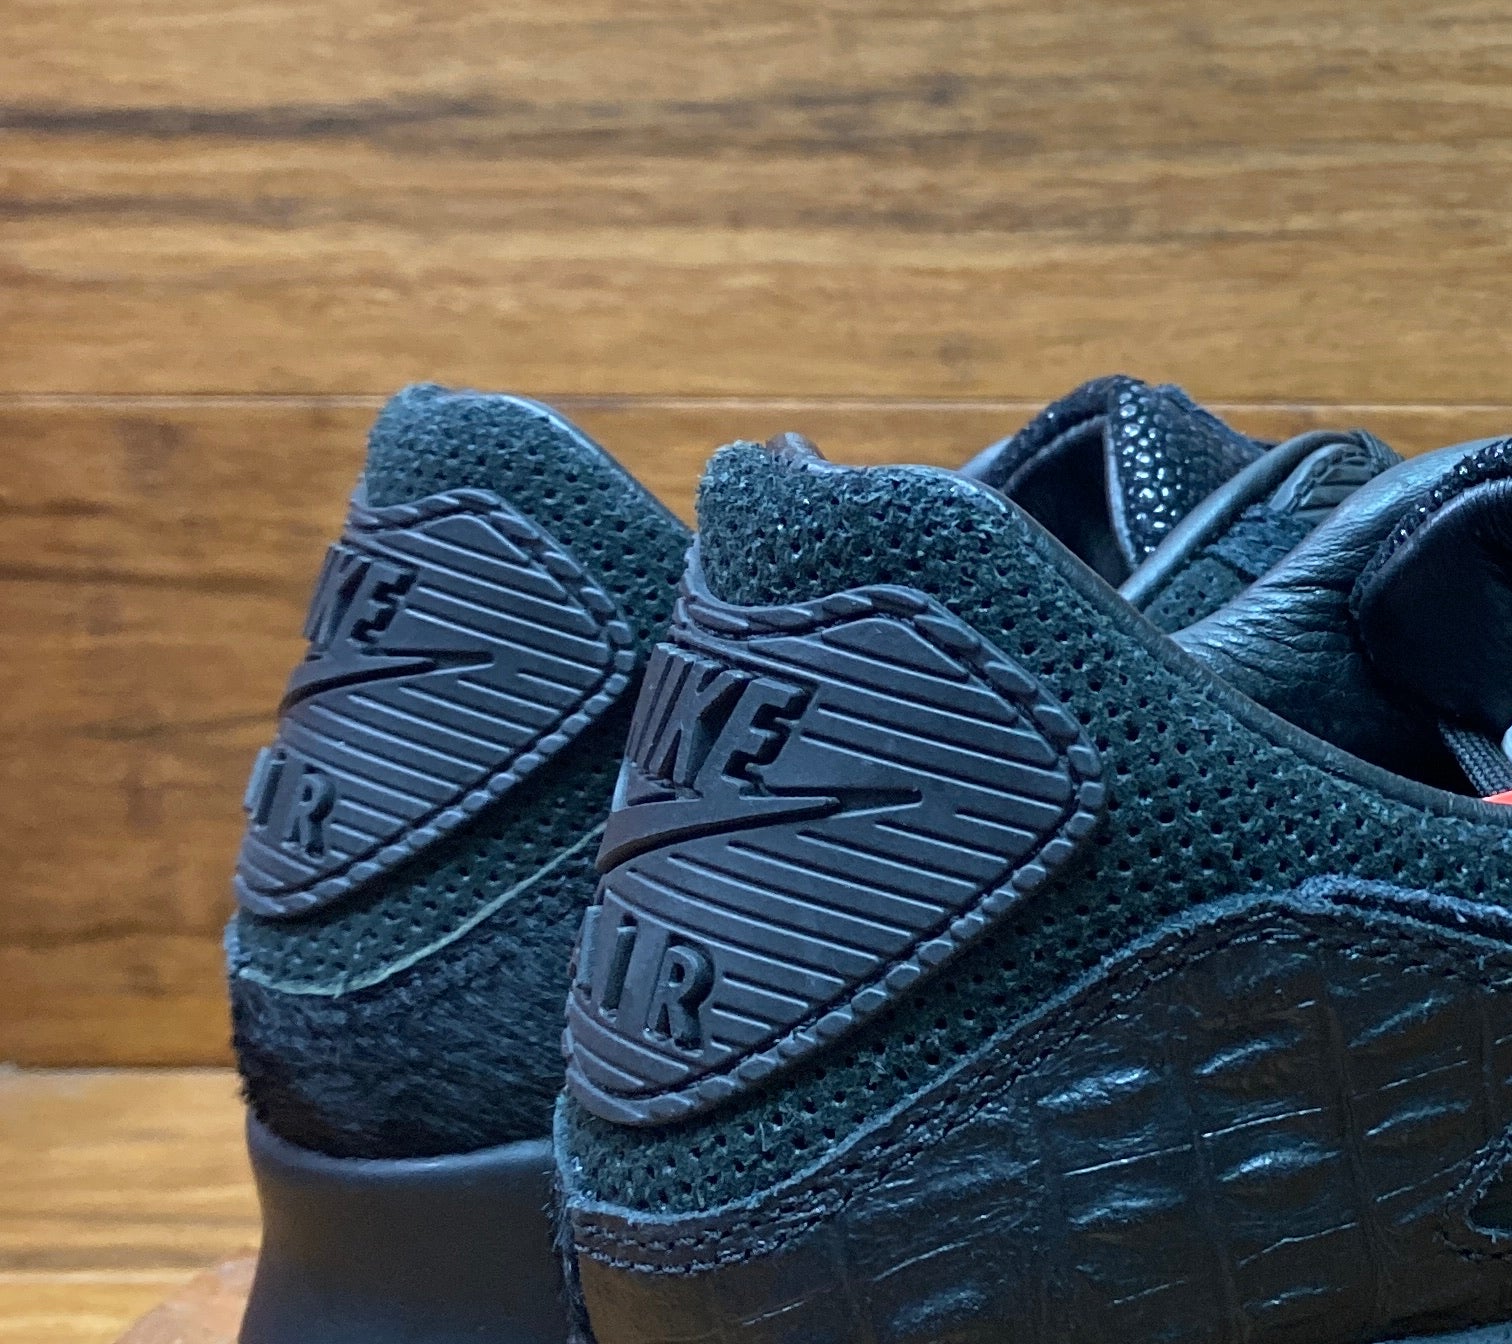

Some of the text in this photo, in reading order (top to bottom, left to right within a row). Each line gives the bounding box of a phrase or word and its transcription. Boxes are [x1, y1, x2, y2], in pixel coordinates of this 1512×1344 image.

[624, 641, 806, 788] IKE
[244, 746, 334, 860] IR
[576, 906, 708, 1054] IR
